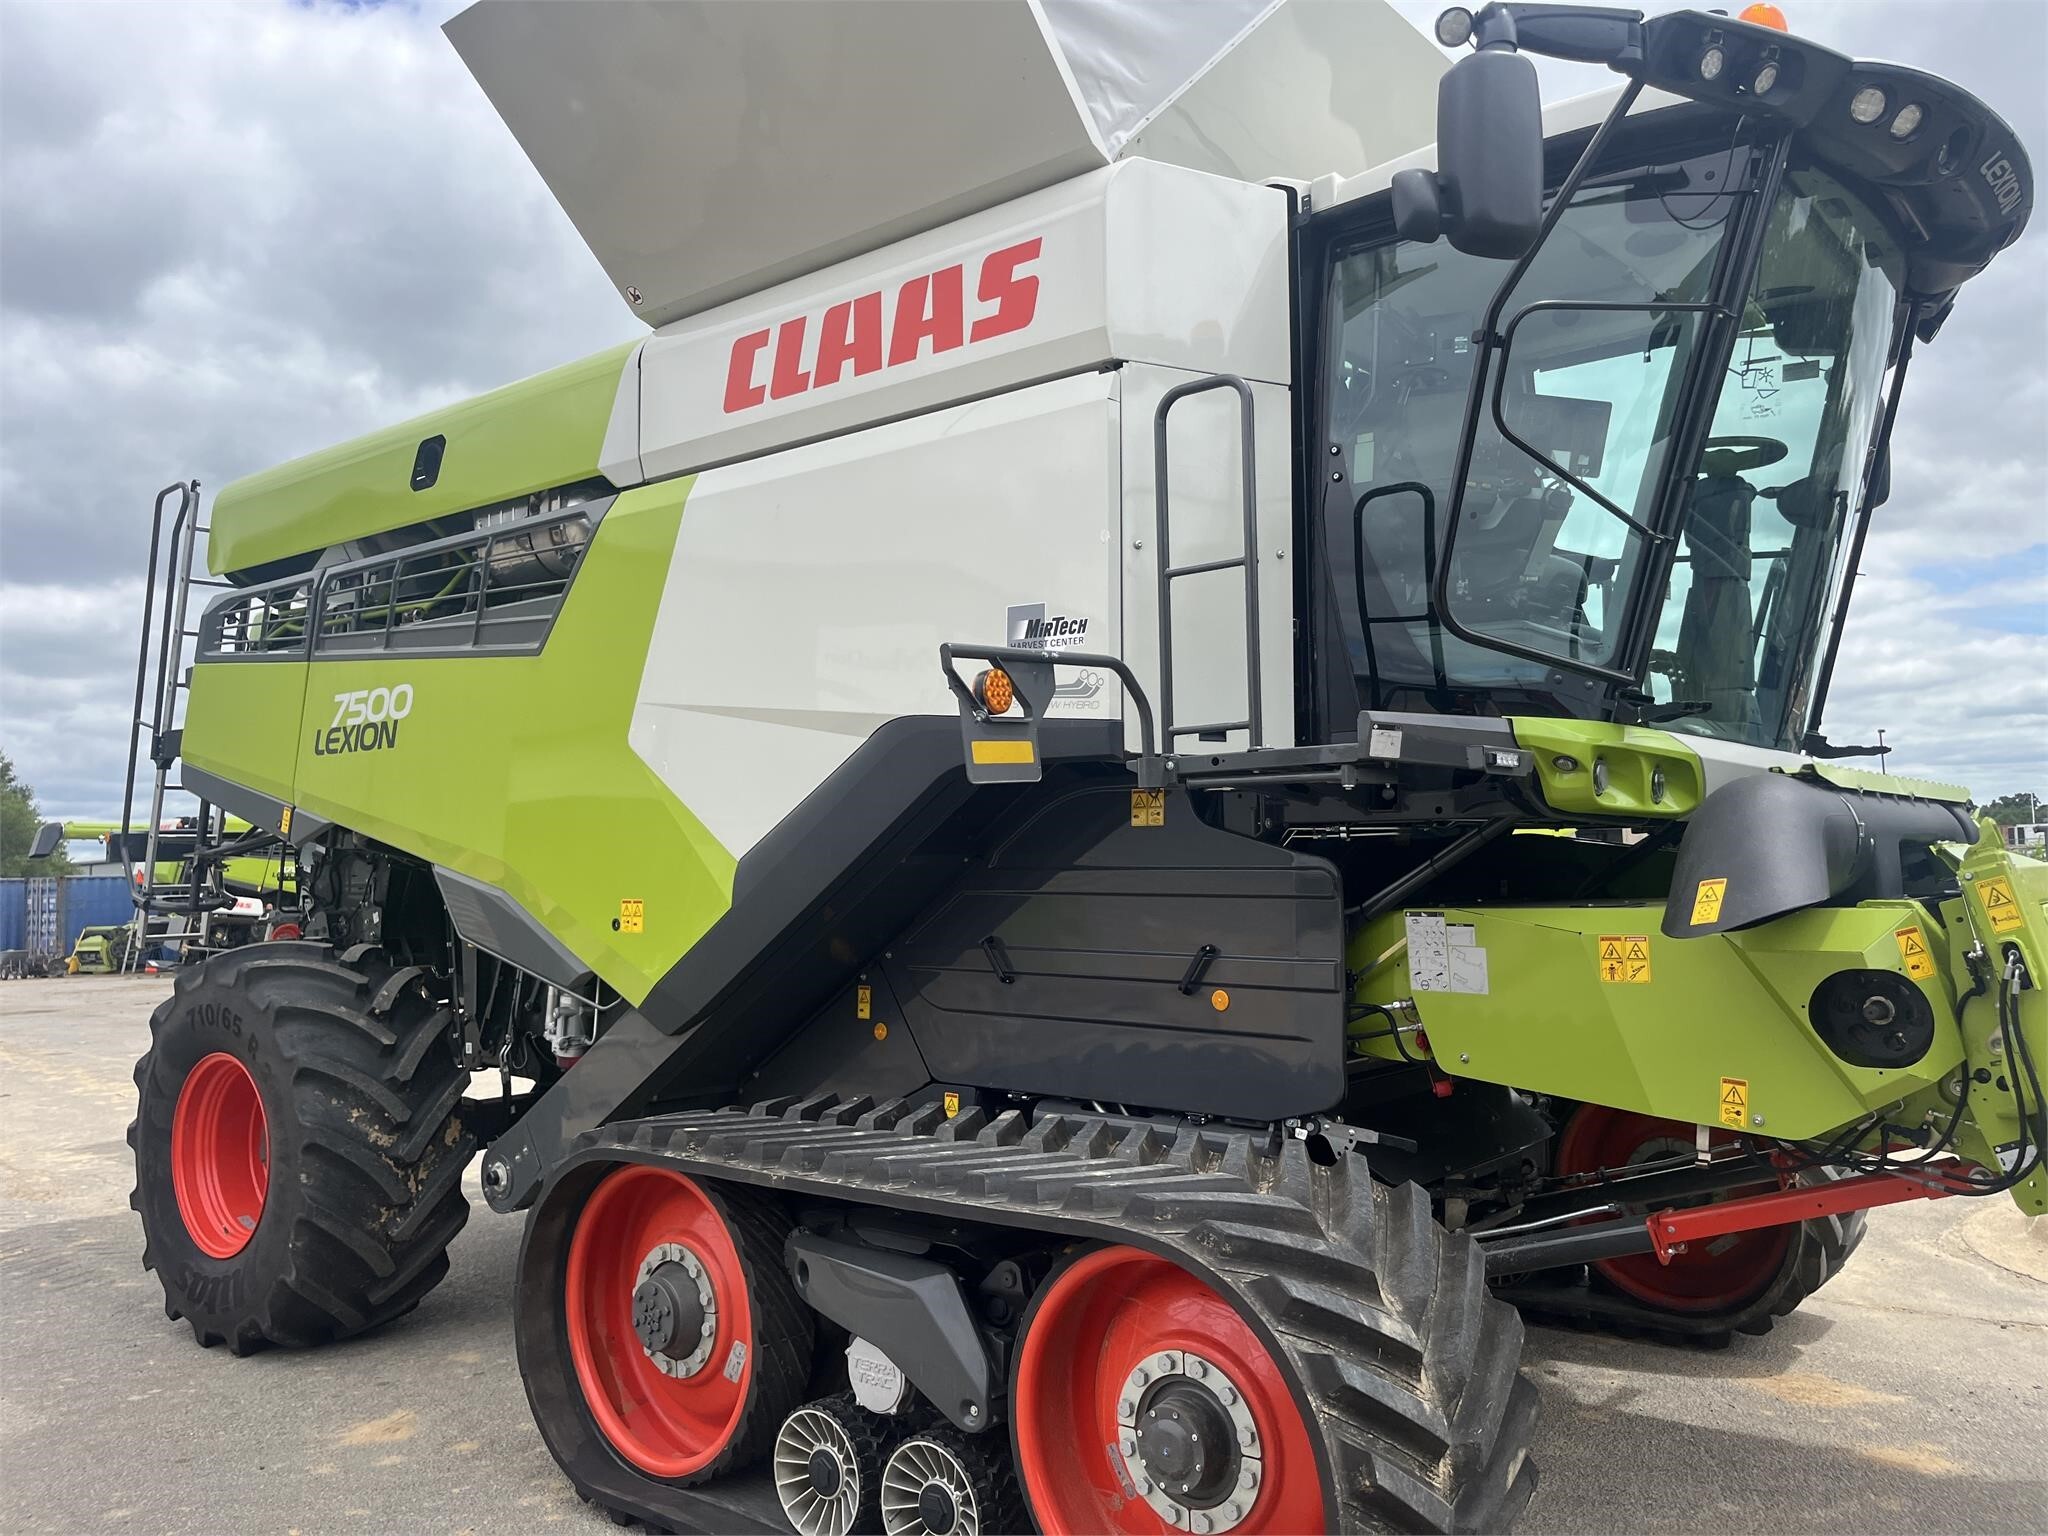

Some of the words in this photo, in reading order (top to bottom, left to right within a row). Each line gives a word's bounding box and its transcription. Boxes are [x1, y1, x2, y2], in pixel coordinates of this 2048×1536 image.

[1980, 150, 2023, 215] LEXION
[723, 236, 1043, 414] CLAAS
[1050, 636, 1085, 647] CENTER
[330, 683, 414, 728] 7500
[314, 719, 399, 756] LEXION
[186, 1003, 243, 1038] 710/65
[853, 1357, 897, 1378] TERRA
[858, 1371, 894, 1390] TRAC
